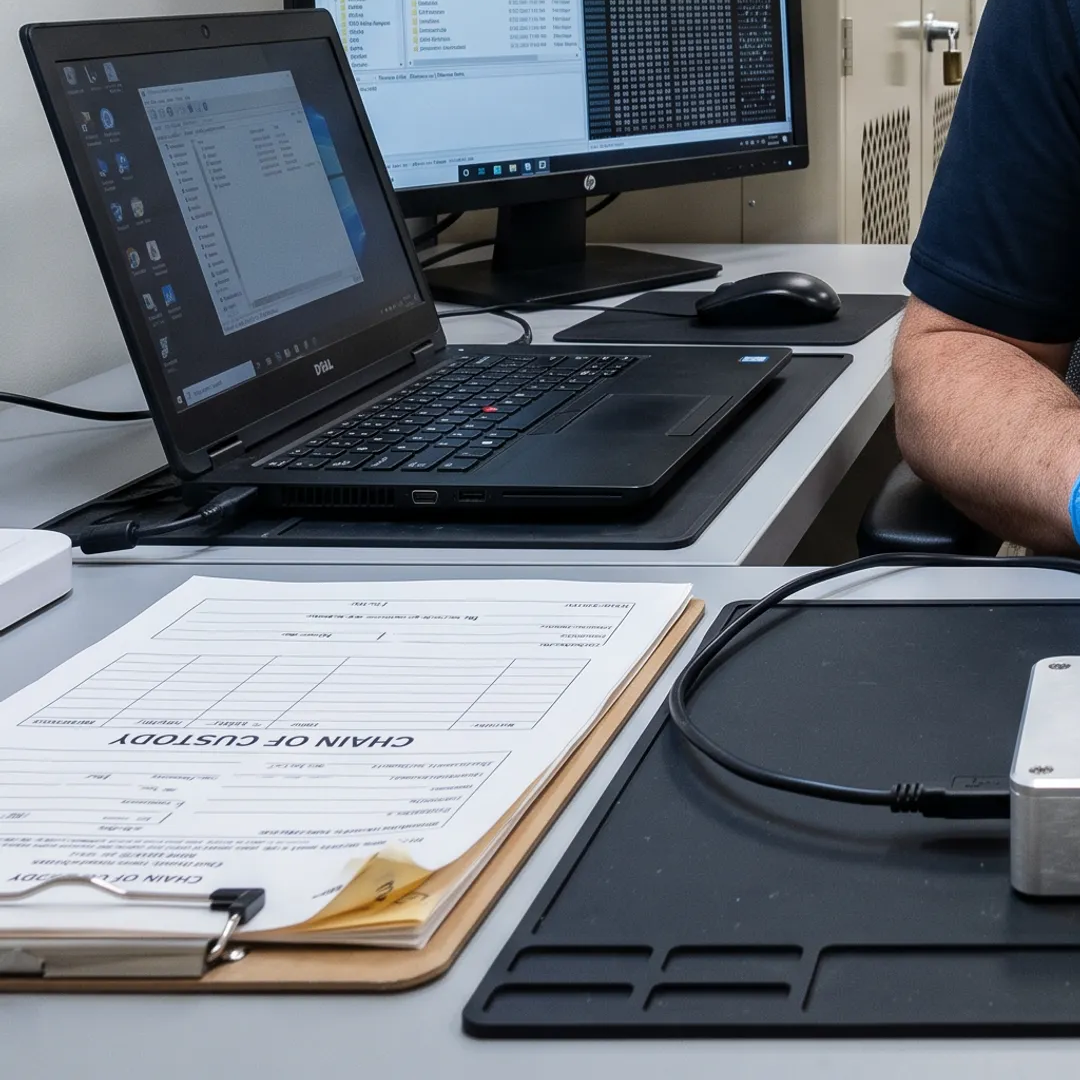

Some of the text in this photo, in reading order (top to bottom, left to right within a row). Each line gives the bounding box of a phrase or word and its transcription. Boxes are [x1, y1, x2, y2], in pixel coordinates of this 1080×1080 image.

[584, 175, 597, 191] hp
[108, 733, 415, 748] CHAIN OF CUSTODY
[112, 874, 139, 884] OF
[143, 874, 203, 885] CHAIN
